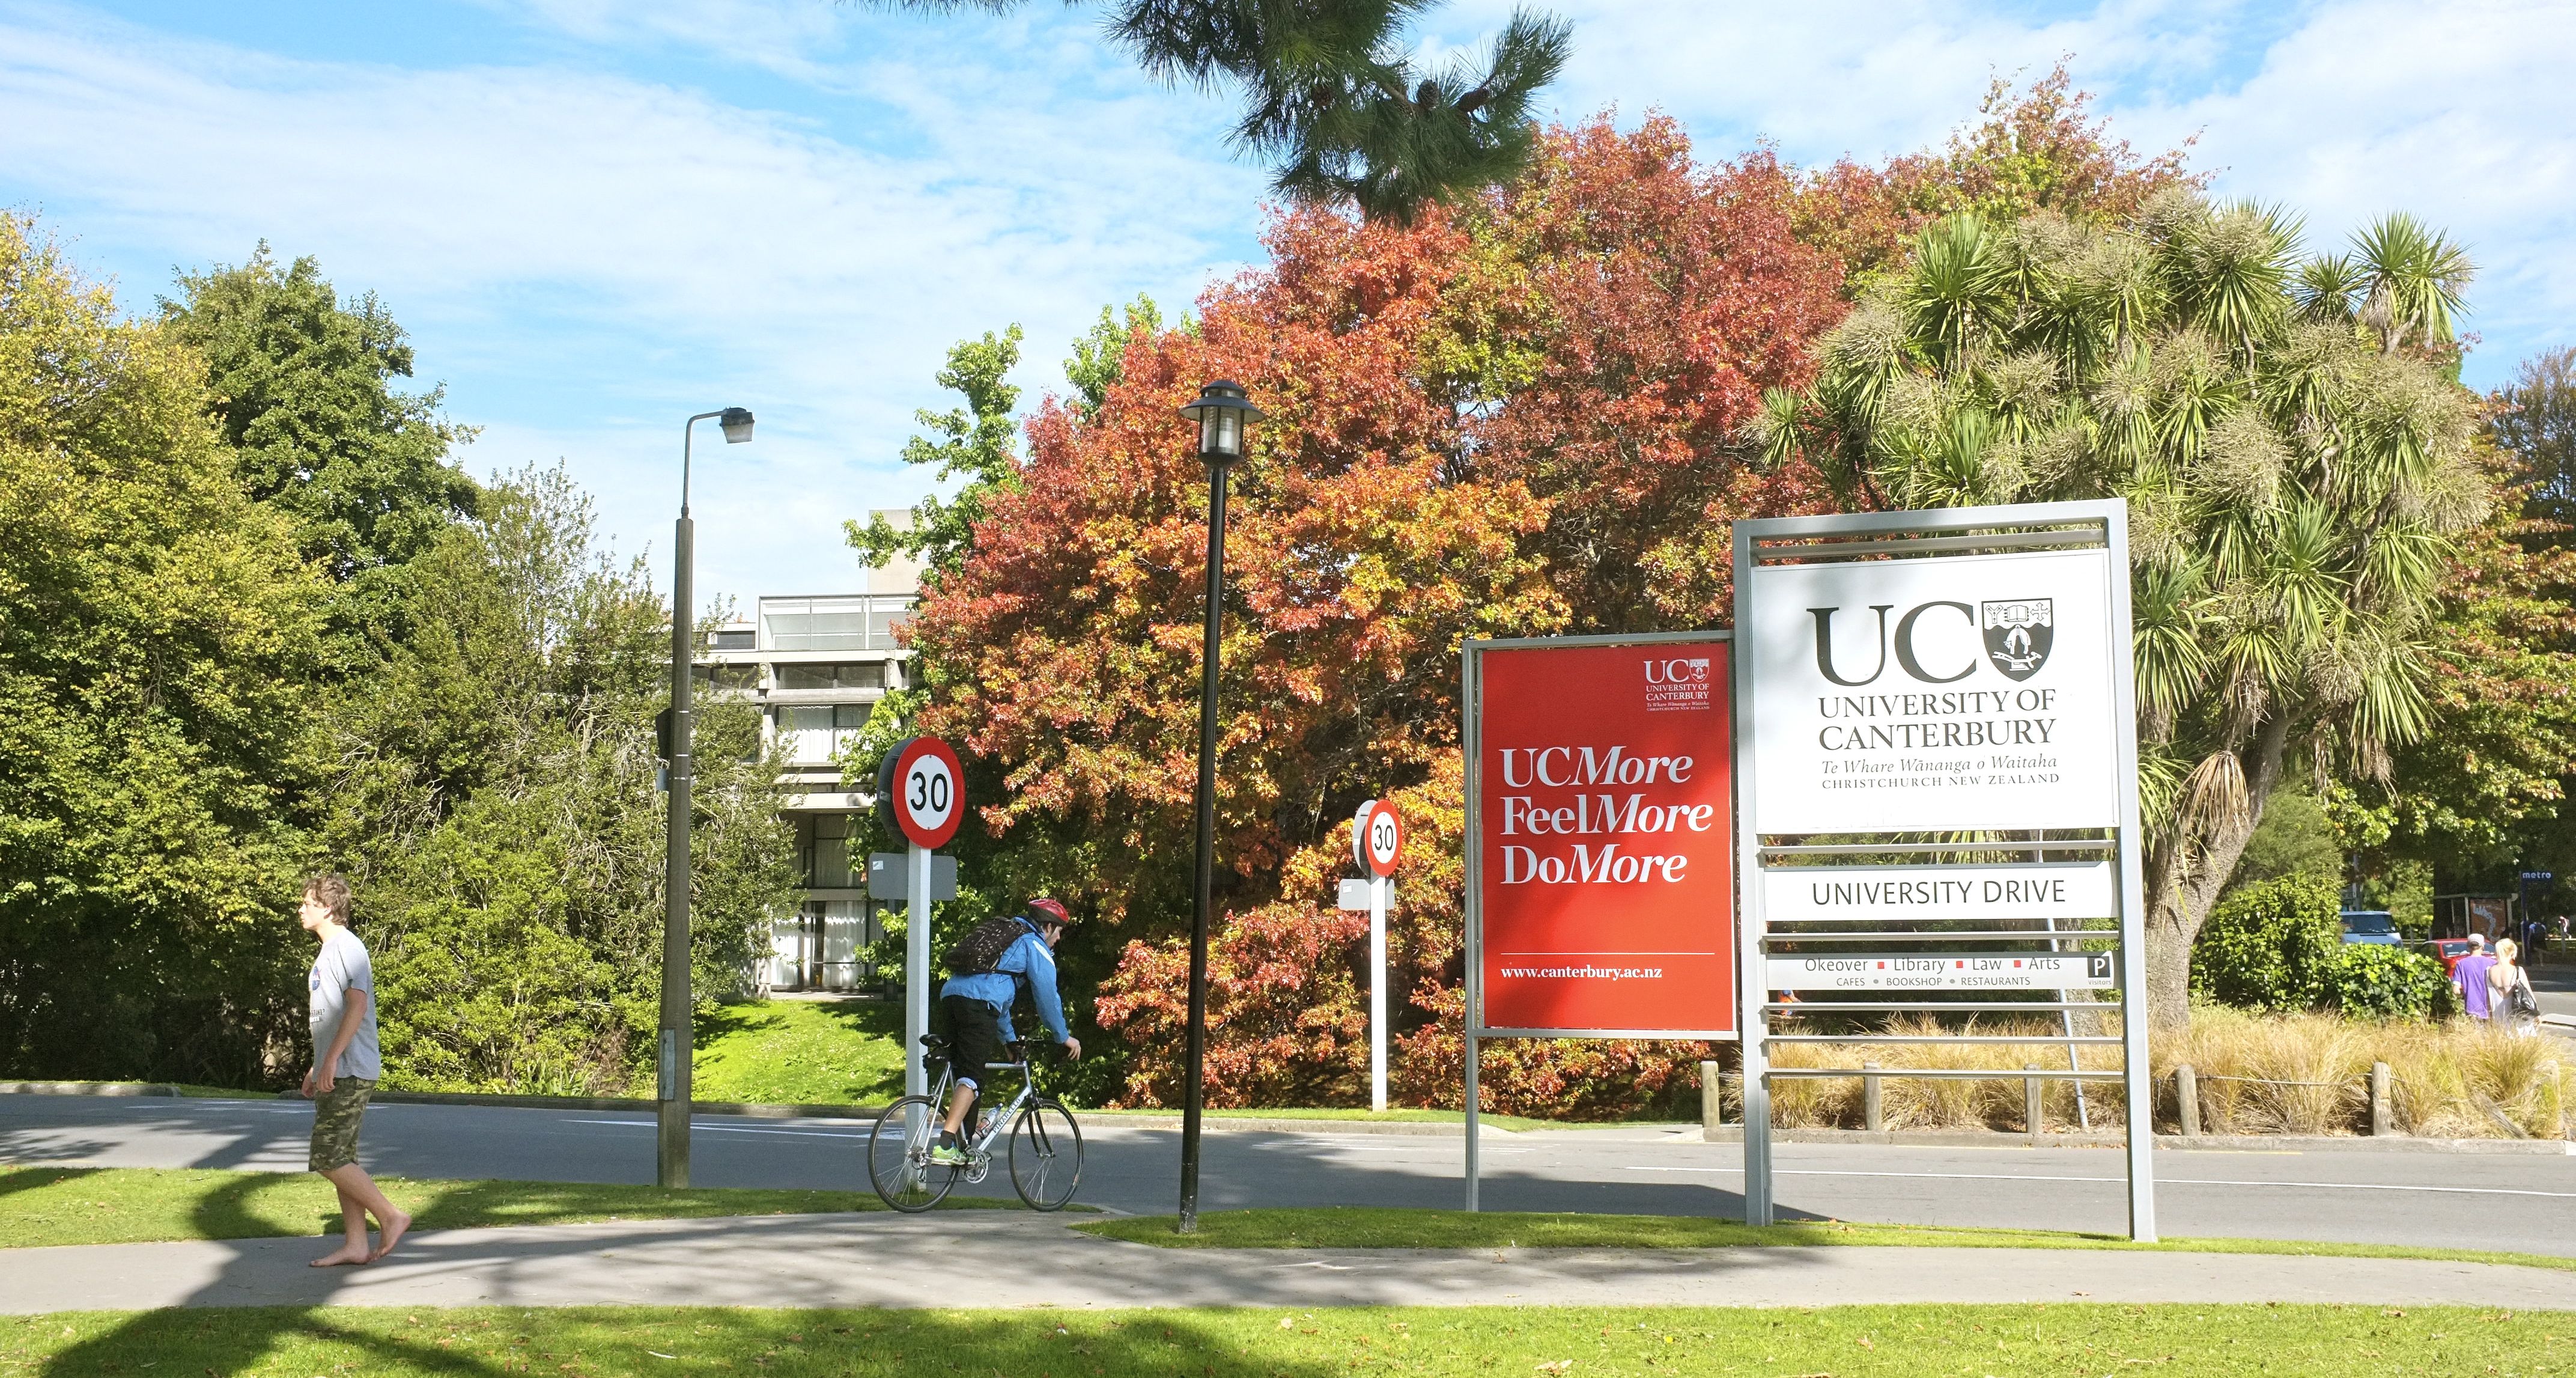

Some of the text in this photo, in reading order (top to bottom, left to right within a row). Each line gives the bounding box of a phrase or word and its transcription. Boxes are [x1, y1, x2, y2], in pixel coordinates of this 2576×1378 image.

[1806, 601, 1976, 686] UC
[1644, 659, 1689, 683] UC
[1646, 684, 1697, 692] UNIVERSITY
[1646, 692, 1709, 701] CANTERBURY
[1818, 689, 2056, 718] UNIVERSITY OF
[1819, 719, 2056, 751] CANTERBURY
[1499, 746, 1694, 788] UCMore
[1822, 761, 1838, 774] Te
[1844, 760, 1894, 773] Whare
[1900, 758, 1970, 774] Wānanga
[1991, 754, 2057, 769] Waitaha
[910, 771, 947, 812] 30
[1822, 773, 2059, 789] CHRISTCHURCH NEW ZEALAND
[1499, 794, 1713, 835] FeelMore
[1375, 825, 1393, 851] 30
[1499, 844, 1687, 884] DoMore
[1813, 880, 2065, 905] UNIVERSITY DRIVE
[1501, 963, 1662, 981] www.canterbury.ac.nz
[1805, 957, 2060, 974] Okeover Library Law Arts
[1836, 977, 2031, 986] CAFES BOOKSHOP RESTAURANTS
